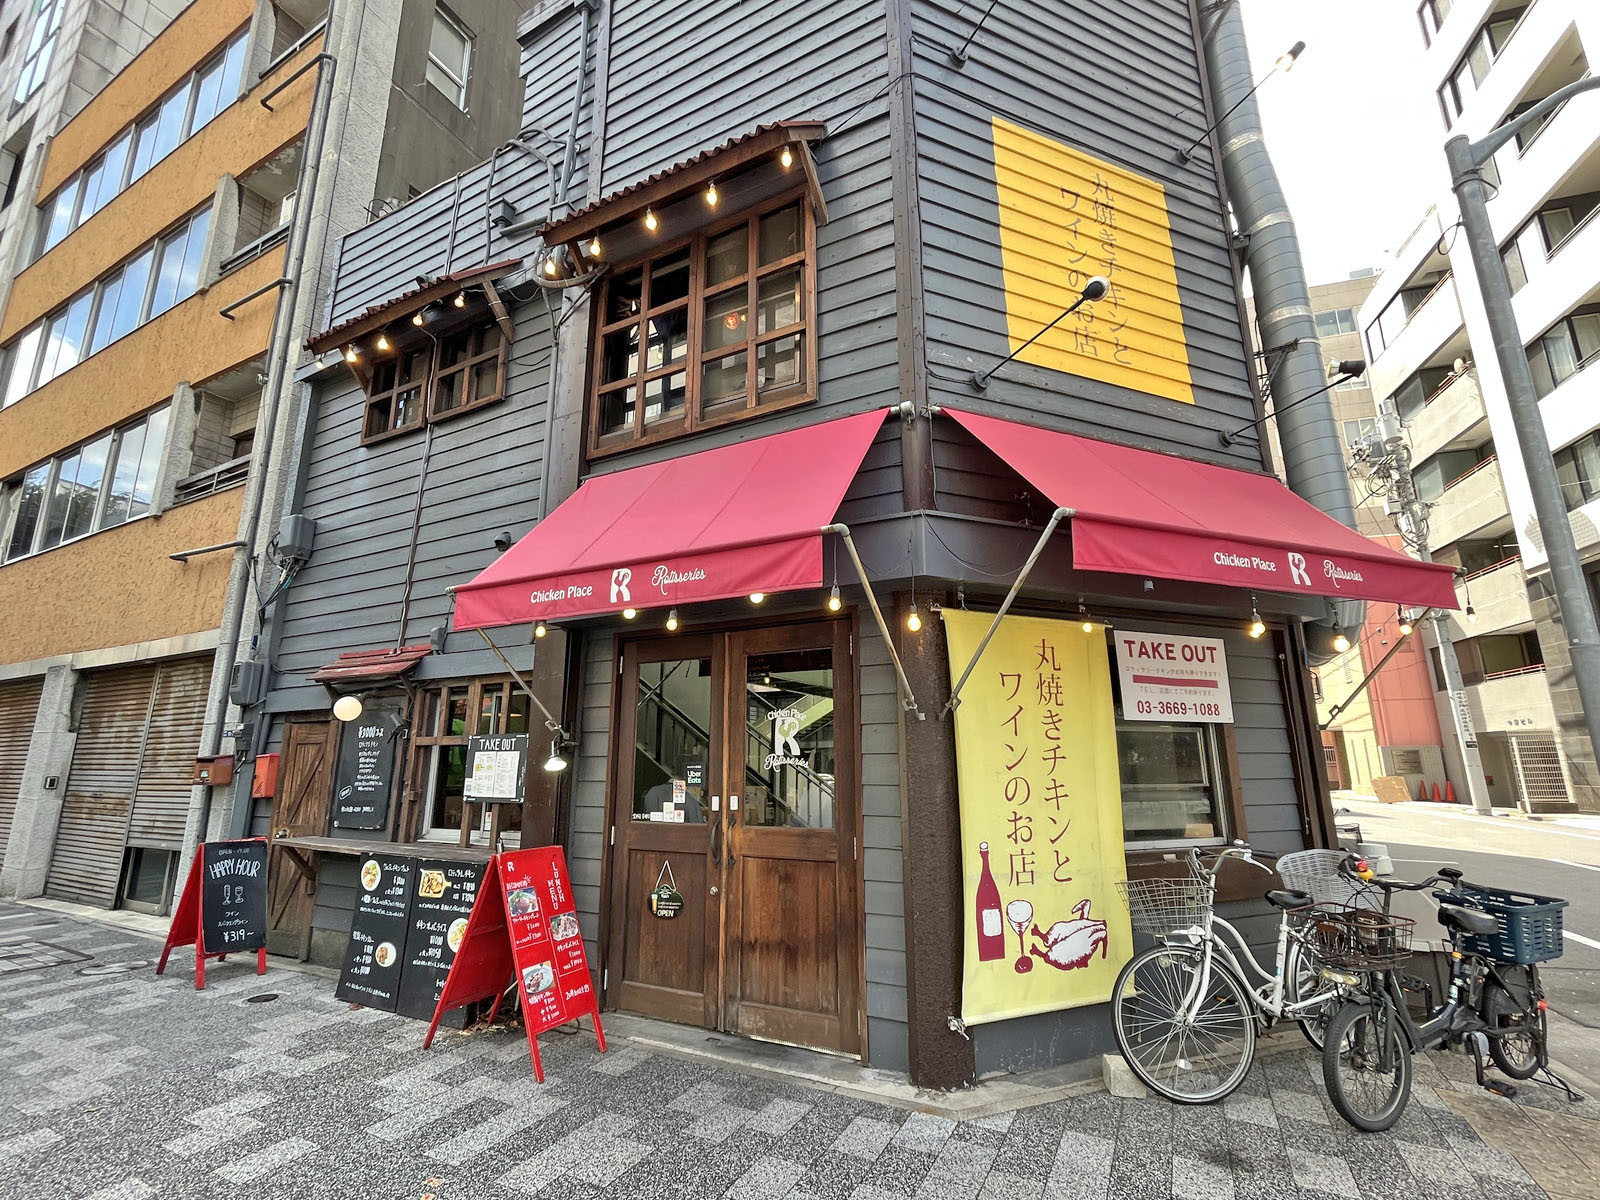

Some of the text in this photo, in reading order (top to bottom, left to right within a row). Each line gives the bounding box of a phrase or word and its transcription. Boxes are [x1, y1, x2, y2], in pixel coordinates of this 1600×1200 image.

[1213, 551, 1251, 568] Chicken
[1251, 557, 1277, 572] Place
[530, 587, 565, 604] Chicken
[567, 585, 593, 599] Place
[1123, 640, 1217, 664] TAKE OUT
[767, 708, 807, 721] Chicken Place
[1137, 700, 1221, 716] 03-3669-1088
[479, 738, 517, 751] TAKE OUT
[1034, 638, 1073, 885] 丸焼きチキンと
[998, 671, 1035, 889] ワインのお店
[209, 857, 261, 880] HAPPY HOUR
[507, 861, 515, 872] R
[552, 861, 565, 903] LUNCH
[547, 880, 559, 911] MENU
[657, 909, 674, 917] OPEN
